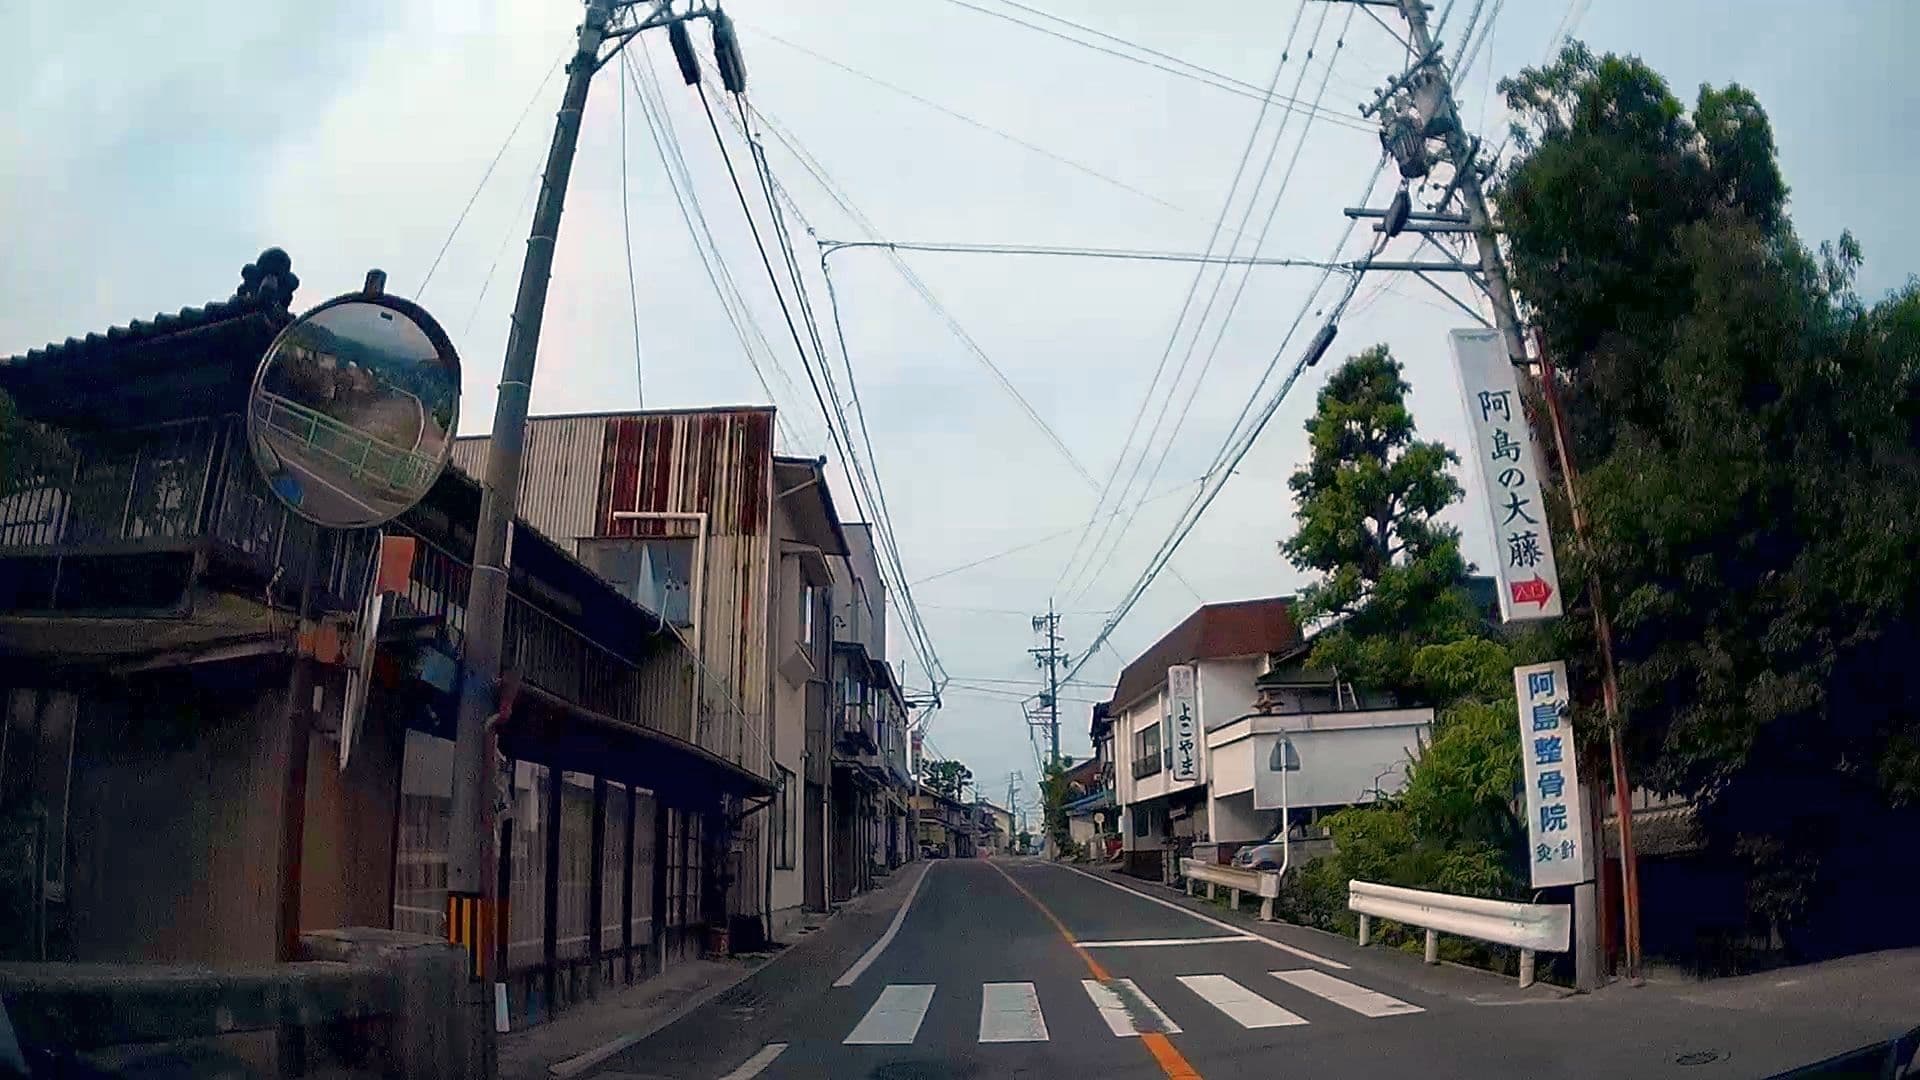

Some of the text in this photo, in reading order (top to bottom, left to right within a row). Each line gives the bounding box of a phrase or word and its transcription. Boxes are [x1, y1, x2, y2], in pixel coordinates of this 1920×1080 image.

[1477, 390, 1545, 568] 阿島の大藤
[1514, 583, 1545, 601] 入口
[1528, 670, 1568, 833] 阿島整骨院
